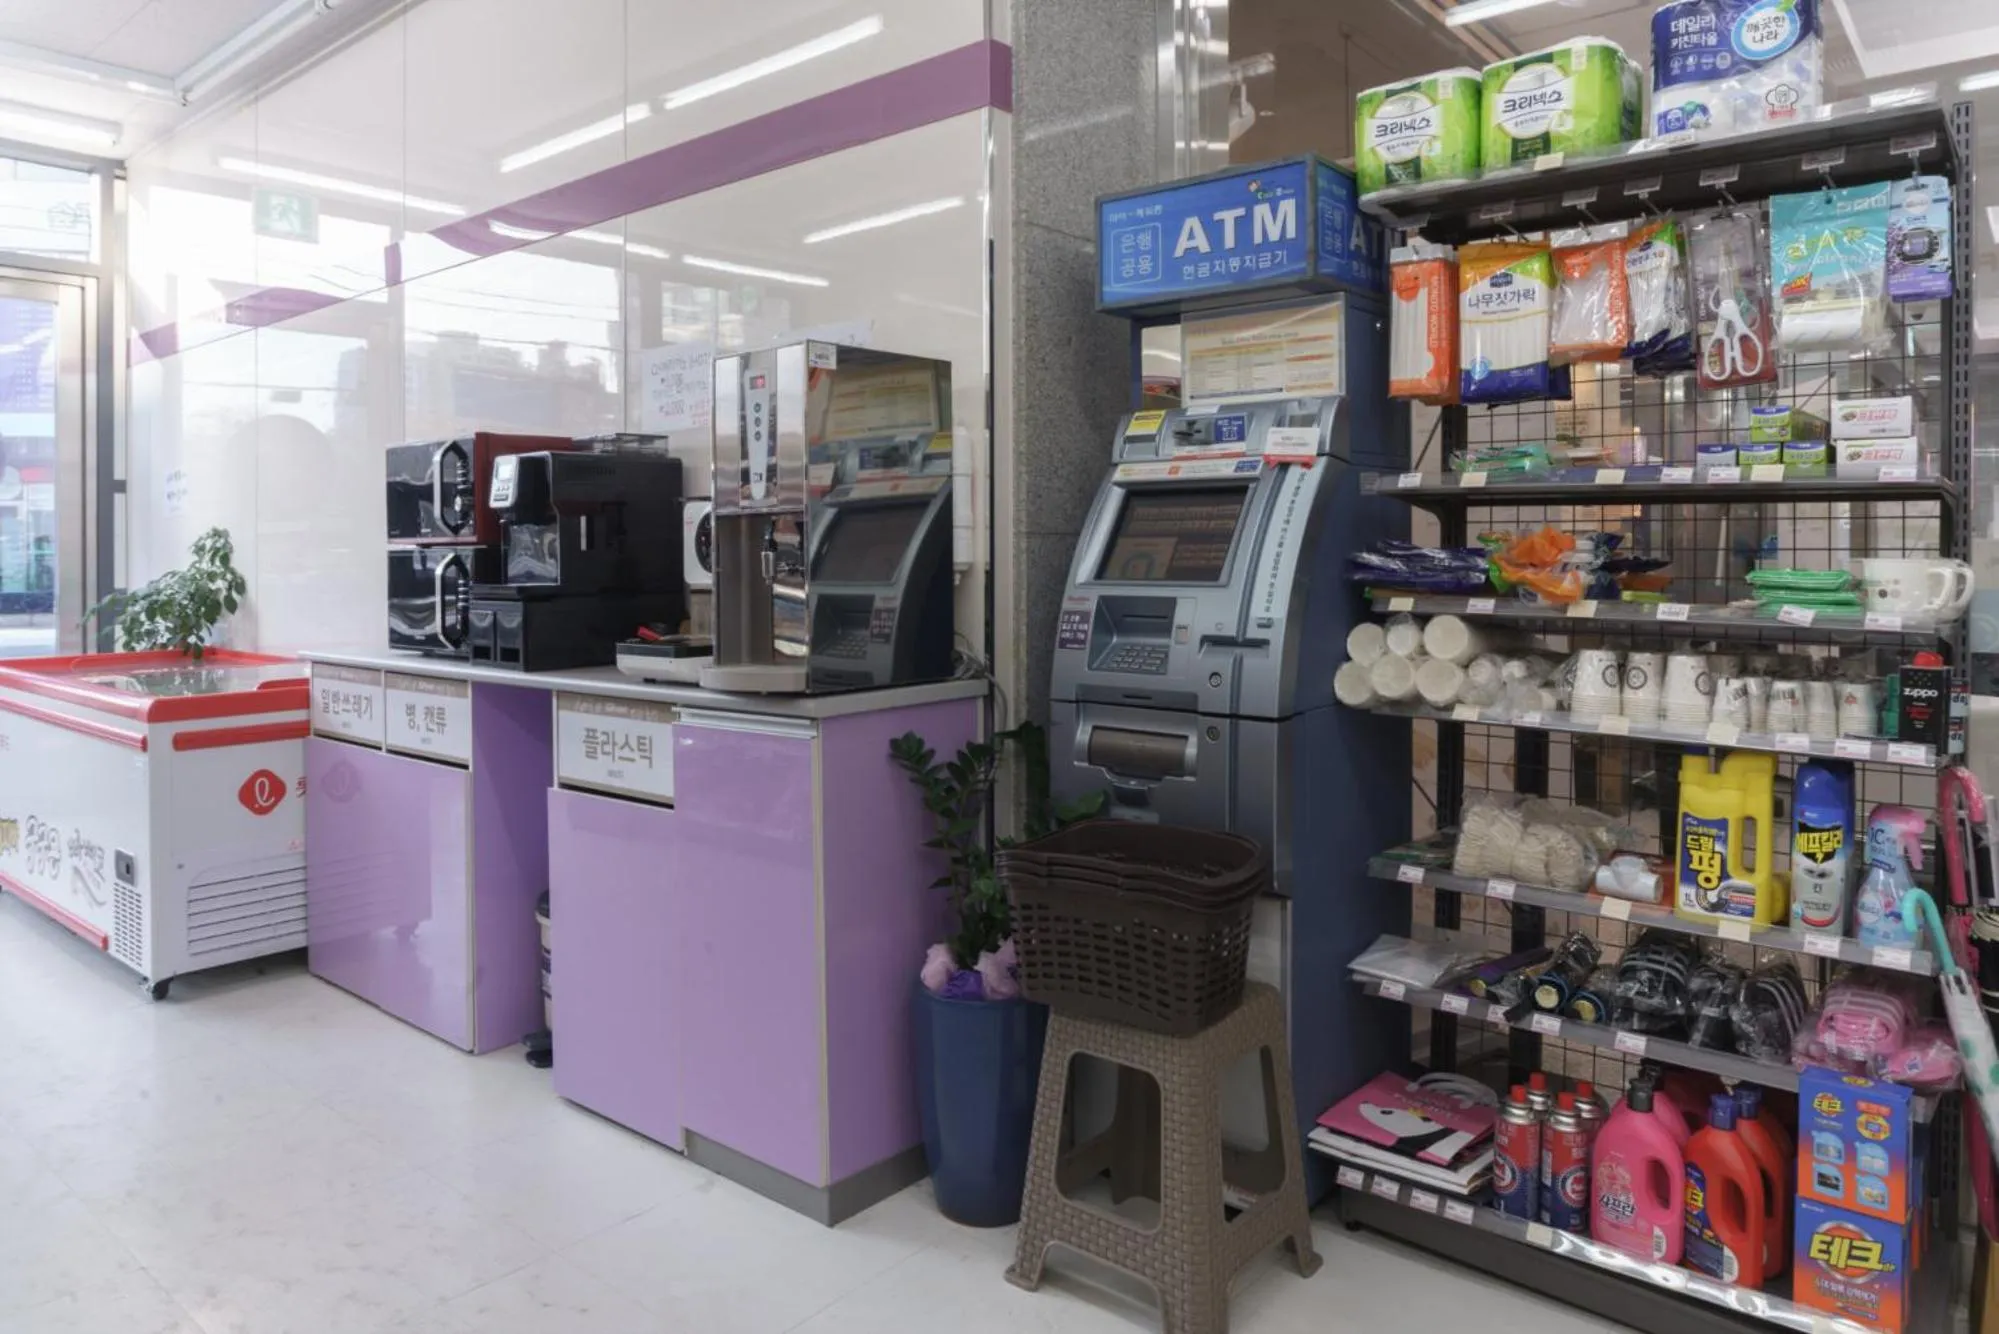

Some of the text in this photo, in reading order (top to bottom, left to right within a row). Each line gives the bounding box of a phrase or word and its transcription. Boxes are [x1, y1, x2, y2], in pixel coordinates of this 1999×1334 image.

[1669, 13, 1717, 34] 데일리
[1746, 16, 1786, 35] 깨끗한
[1752, 29, 1779, 45] 나라
[1502, 89, 1564, 114] 크리넥스
[1374, 116, 1433, 138] 크리넥스
[1173, 198, 1297, 258] ATM
[1119, 230, 1153, 254] 은행
[1120, 254, 1153, 279] 공용
[1182, 249, 1289, 281] 현금자동지급기
[1468, 287, 1536, 309] 나무젓가락
[320, 687, 374, 722] 일반쓰레기
[582, 727, 653, 769] 플라스틱
[1796, 828, 1844, 853] 에프킬라
[1808, 1232, 1886, 1271] 테크
